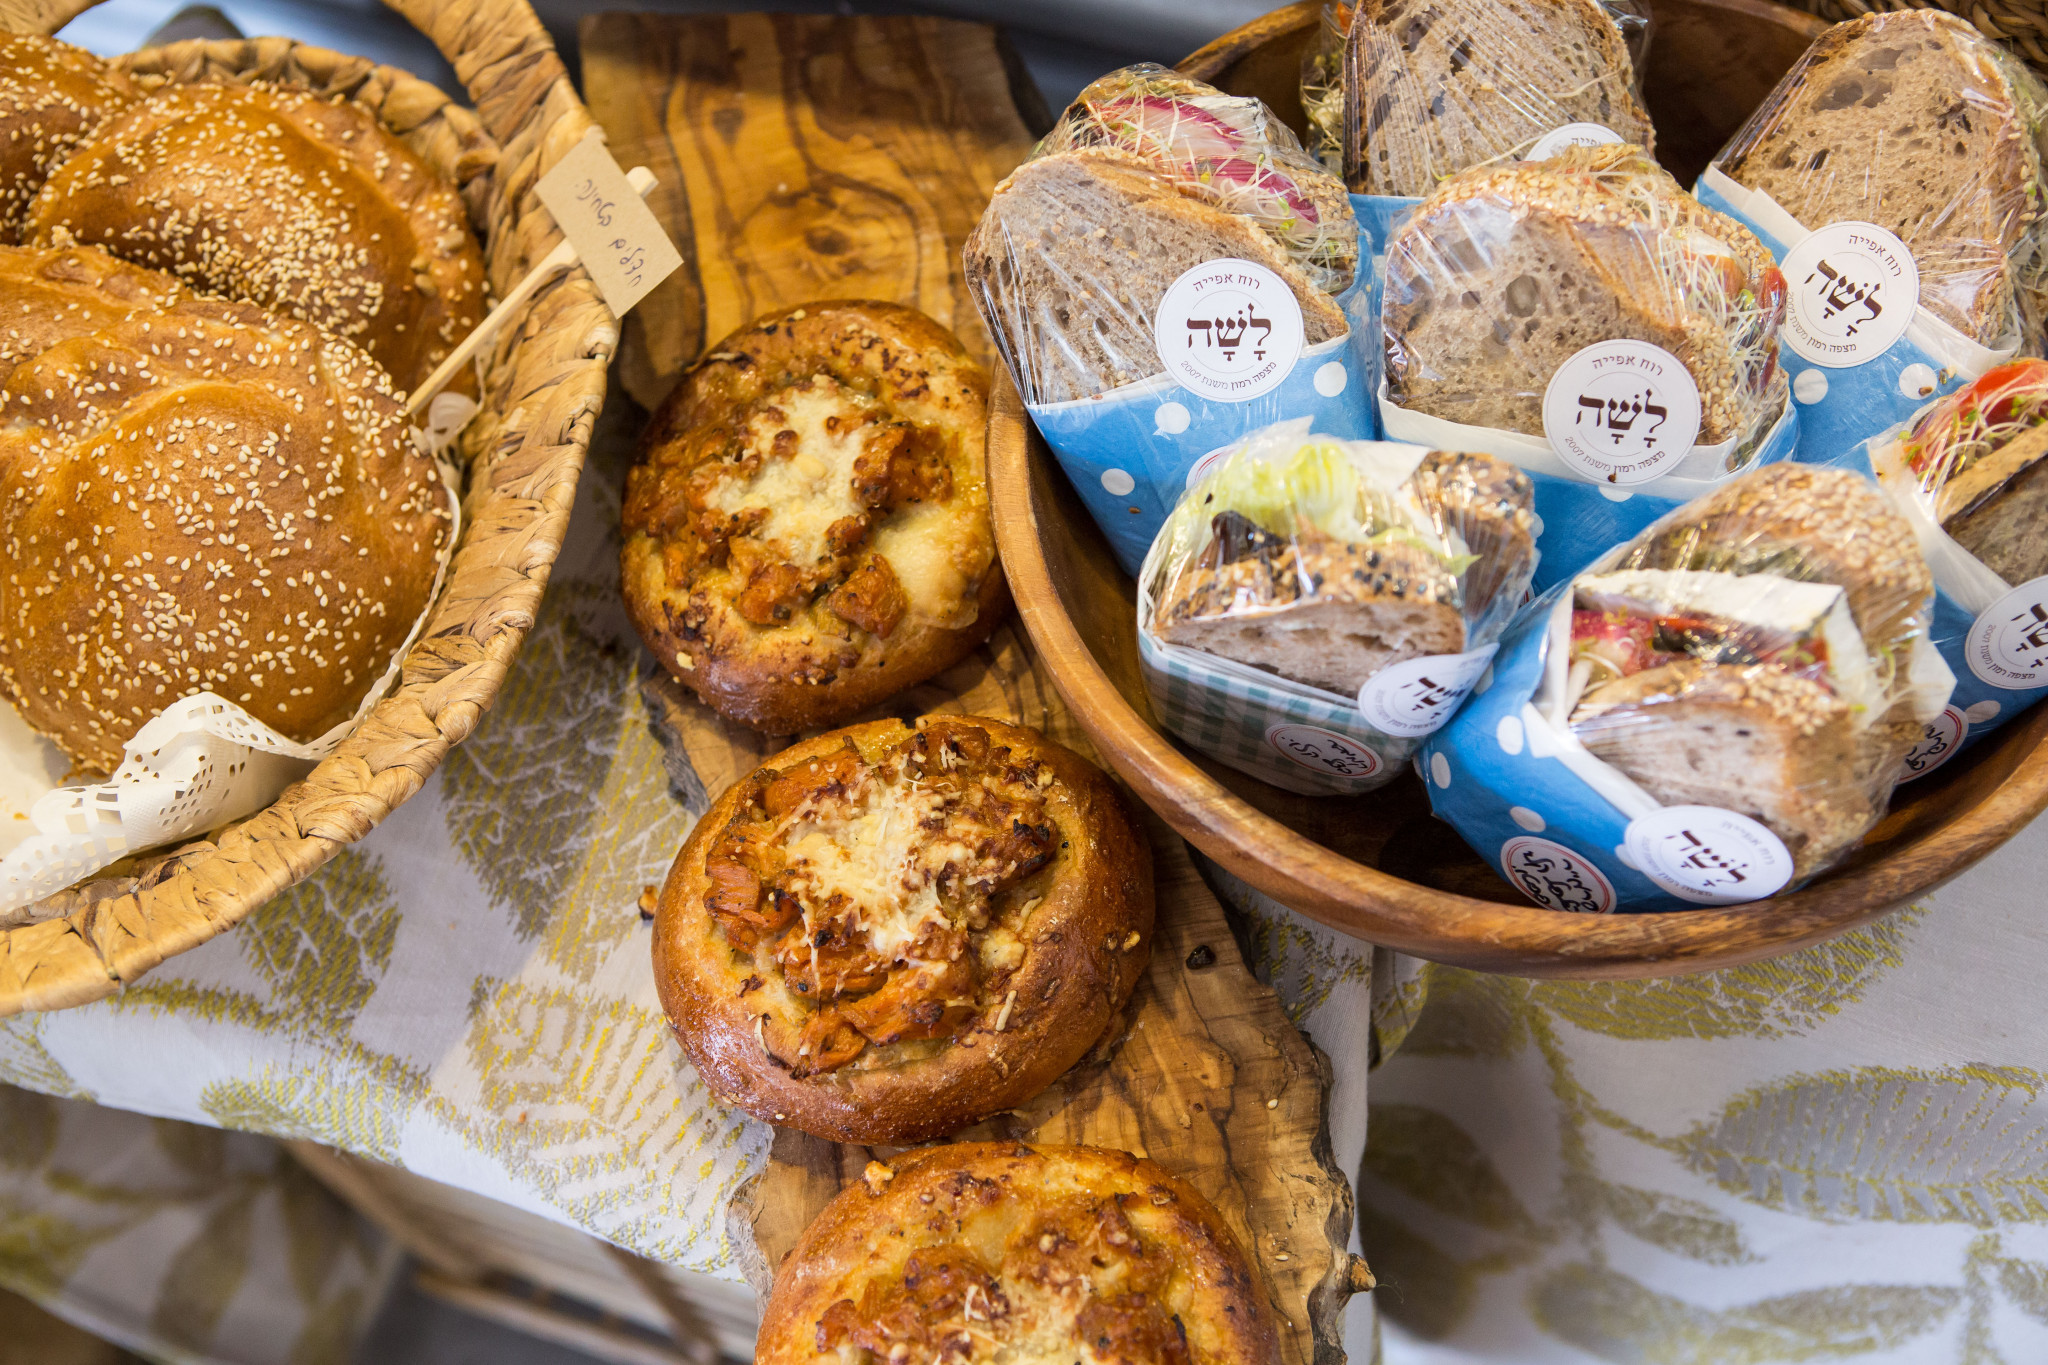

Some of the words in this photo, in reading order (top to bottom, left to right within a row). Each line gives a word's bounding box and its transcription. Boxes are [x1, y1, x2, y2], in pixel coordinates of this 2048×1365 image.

[1571, 137, 1601, 147] פייה
[1848, 234, 1887, 257] אפייה
[1885, 254, 1902, 277] רוח
[1193, 273, 1233, 291] אפייה
[1238, 274, 1260, 290] רוח
[1790, 315, 1809, 340] משנת
[1806, 336, 1827, 351] רמון
[1829, 343, 1857, 353] מצפה
[1181, 360, 1201, 378] 2007
[1592, 355, 1635, 369] אפייה
[1640, 358, 1663, 376] רוח
[1252, 361, 1277, 383] מצפה
[1201, 376, 1229, 390] משנת
[1231, 379, 1252, 391] רמון
[1565, 436, 1585, 457] 2007
[1583, 454, 1611, 472] משנת
[1638, 450, 1665, 470] מצפה
[1614, 464, 1636, 474] רמון
[1987, 663, 2007, 676] רמון
[2007, 671, 2036, 680] מצפה
